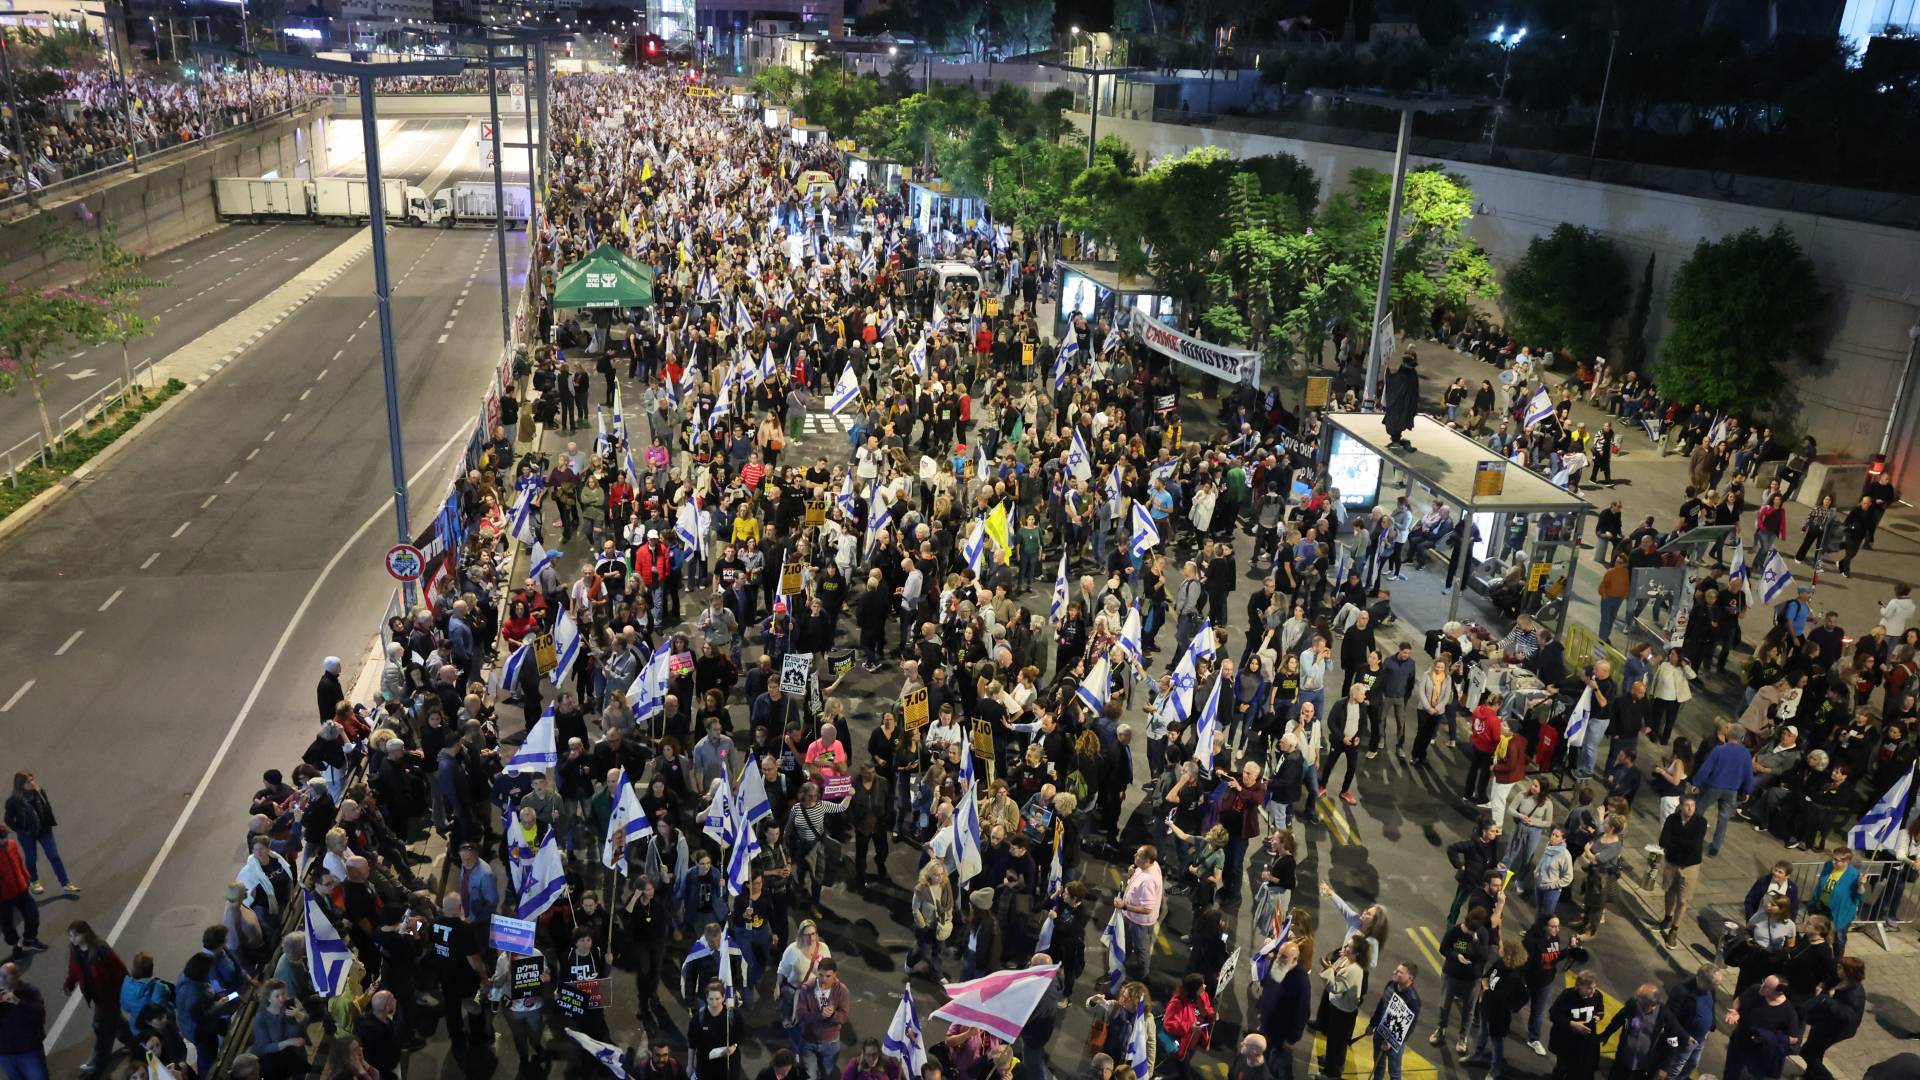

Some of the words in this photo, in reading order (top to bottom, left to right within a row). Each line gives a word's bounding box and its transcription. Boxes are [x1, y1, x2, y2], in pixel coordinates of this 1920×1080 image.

[1180, 339, 1240, 376] MINISTER
[1280, 431, 1299, 453] Save
[806, 501, 825, 510] 7.10
[783, 564, 801, 576] 7.10
[533, 633, 553, 651] 7.10
[903, 689, 927, 707] 7.10
[972, 719, 992, 736] 7.10
[515, 970, 540, 981] קוראים
[516, 963, 539, 974] חיילים
